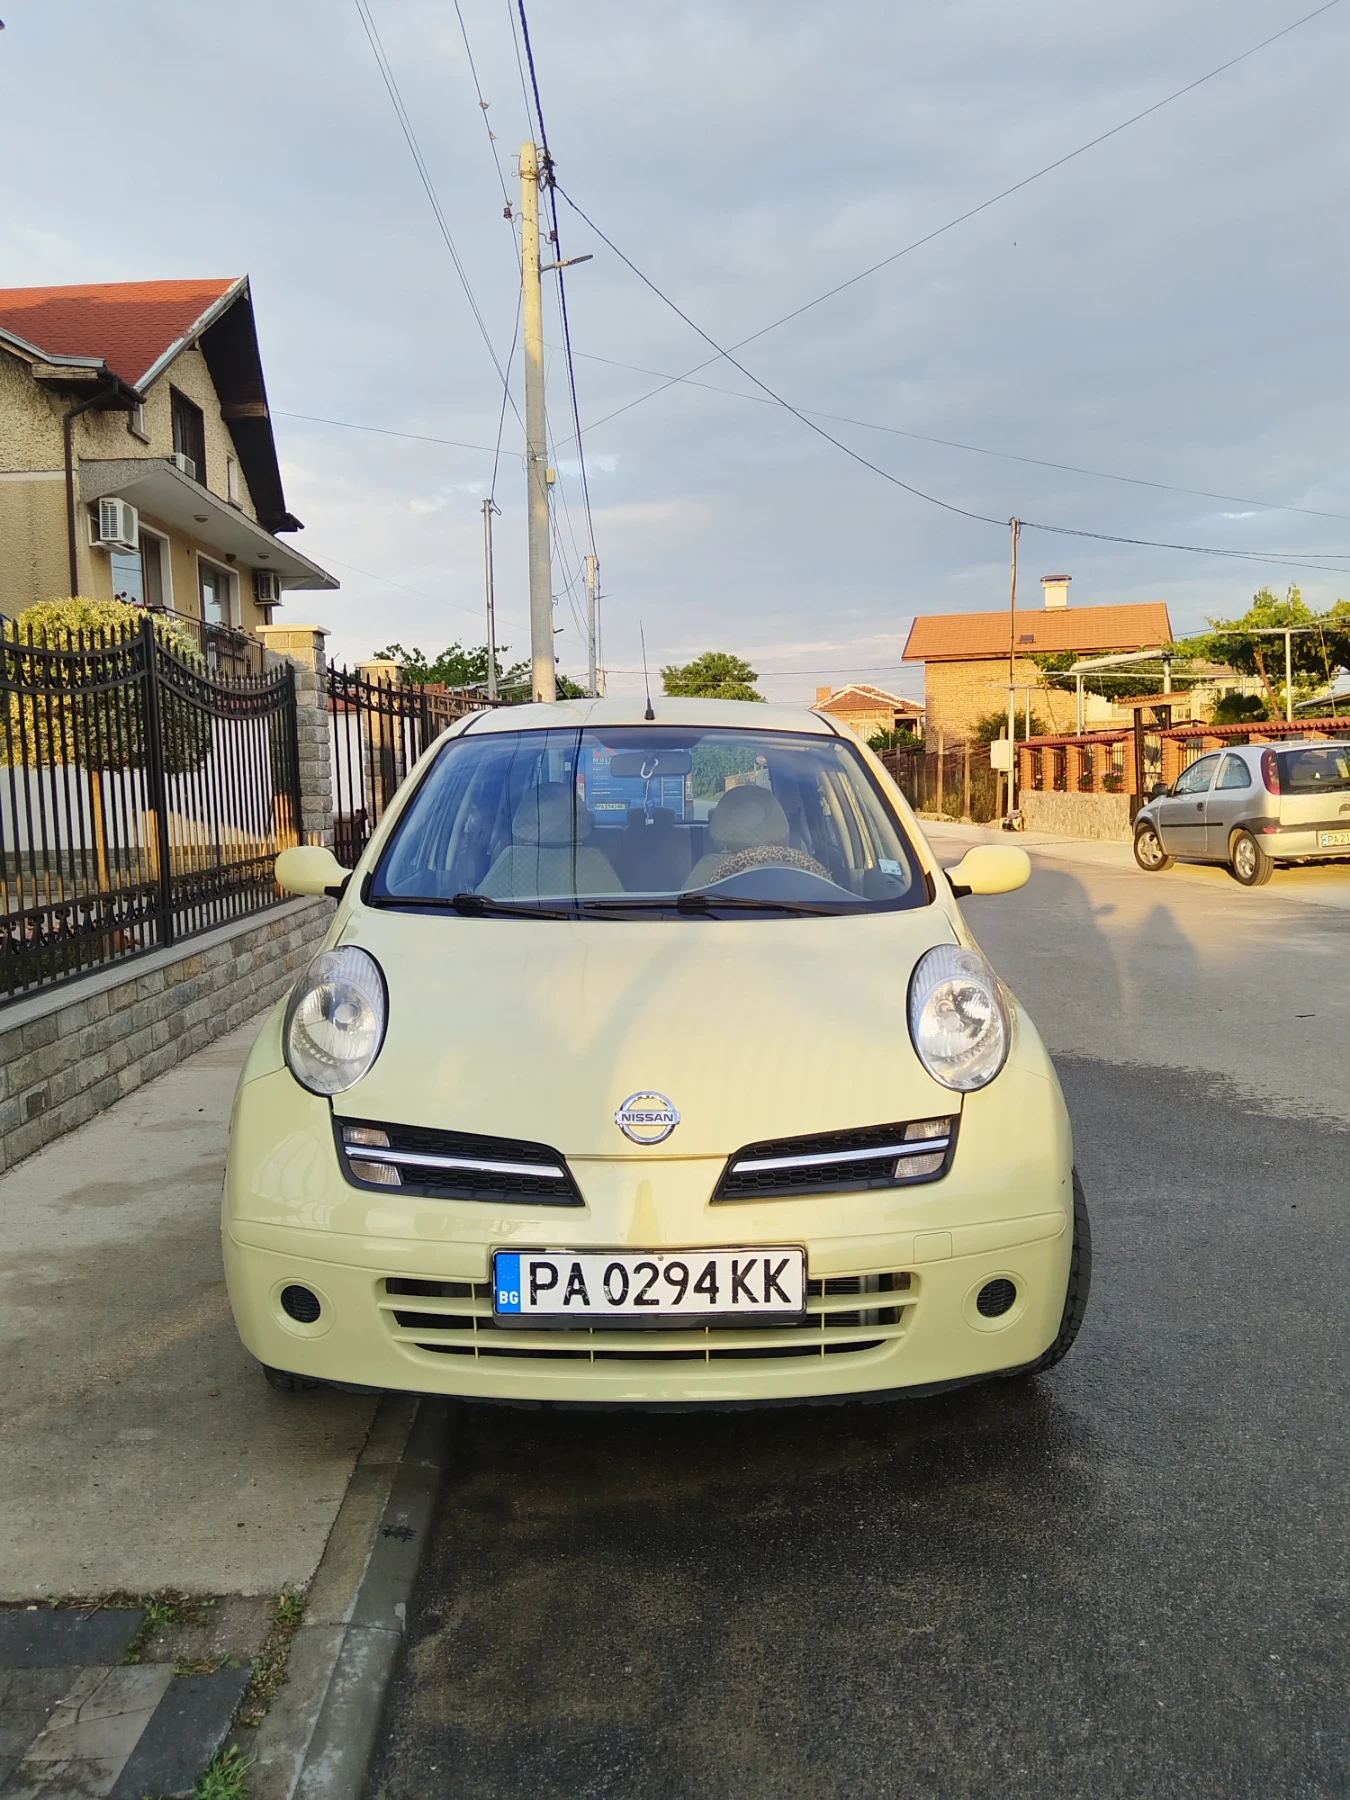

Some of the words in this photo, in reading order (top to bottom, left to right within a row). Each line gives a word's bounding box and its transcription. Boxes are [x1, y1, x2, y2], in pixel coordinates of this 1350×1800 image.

[621, 1113, 674, 1122] NISSAN
[529, 1261, 591, 1306] PA
[603, 1260, 720, 1306] 0294
[731, 1258, 792, 1304] KK
[499, 1290, 519, 1305] BG
